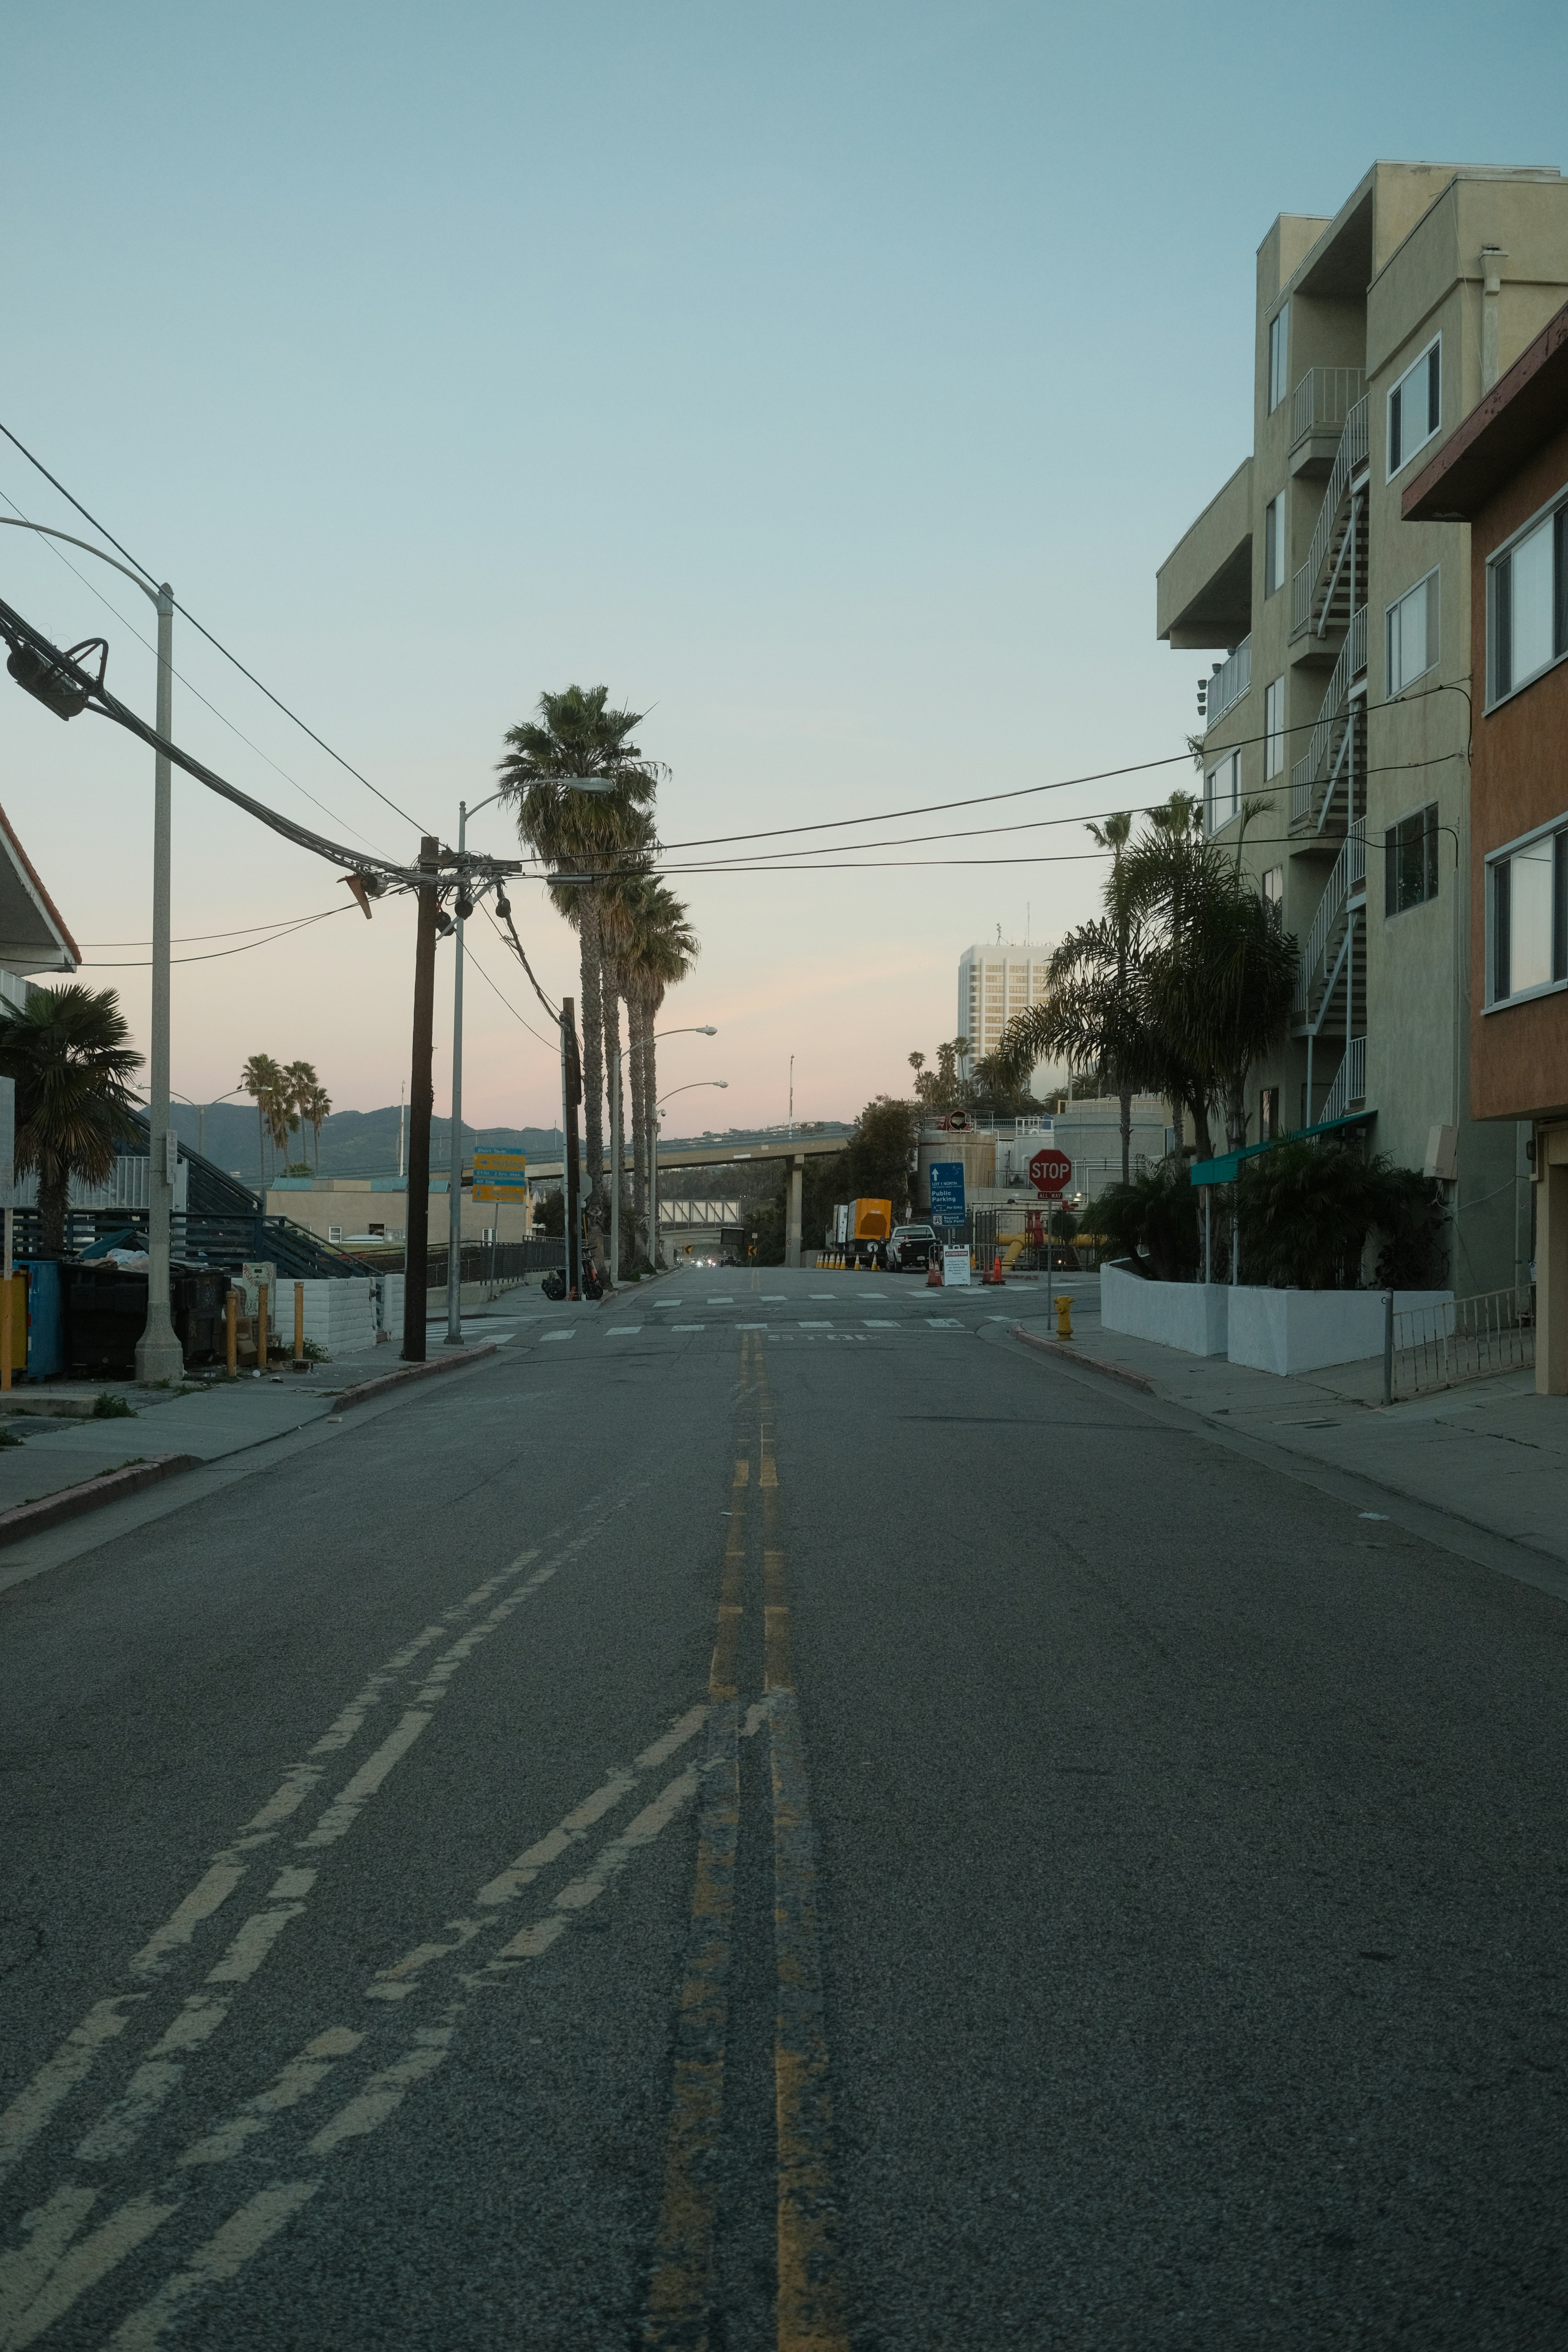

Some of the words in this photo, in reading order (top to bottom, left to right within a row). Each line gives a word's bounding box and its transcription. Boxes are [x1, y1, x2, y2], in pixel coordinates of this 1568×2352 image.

[493, 1159, 522, 1168] Parking
[1032, 1162, 1069, 1179] STOP
[491, 1190, 521, 1199] Parking
